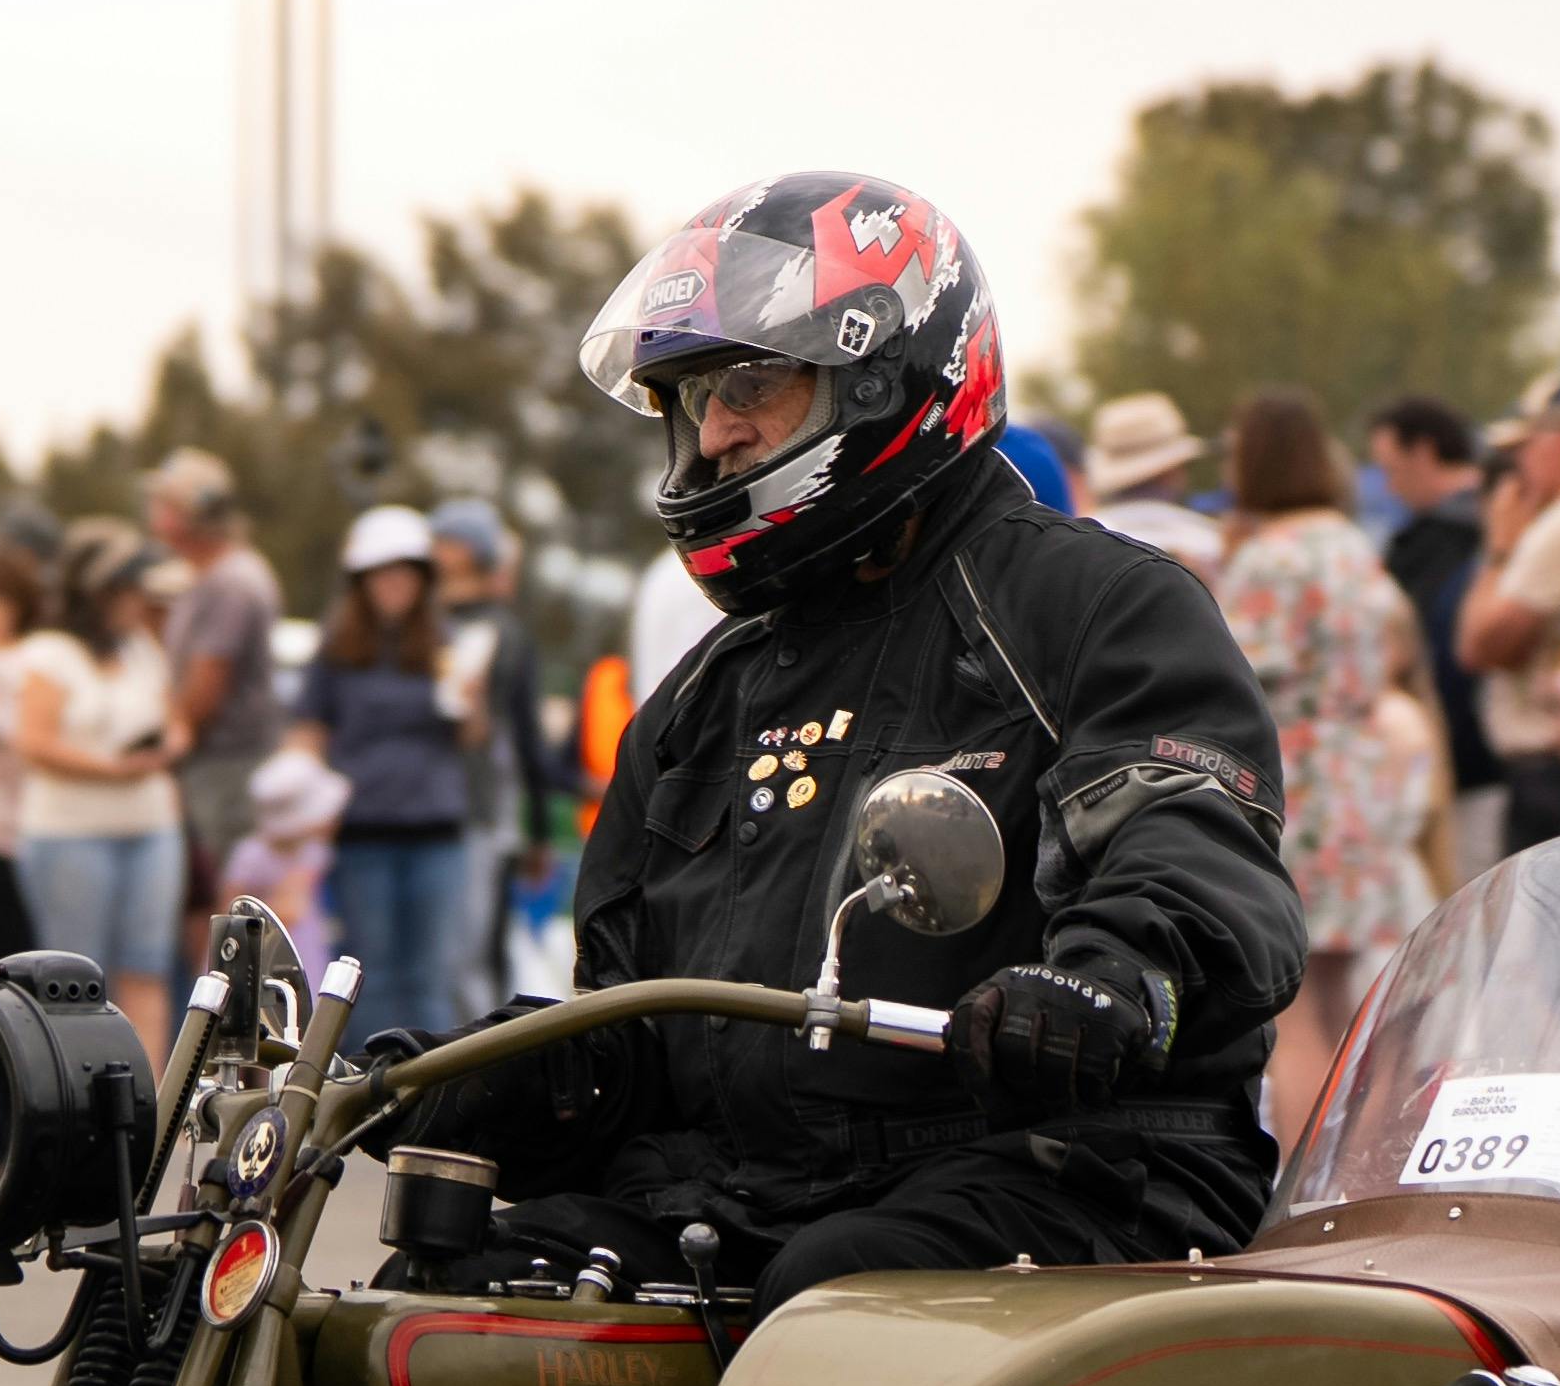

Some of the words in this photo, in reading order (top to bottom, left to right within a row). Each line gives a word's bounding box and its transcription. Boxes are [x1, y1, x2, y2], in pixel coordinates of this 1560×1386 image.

[644, 275, 696, 312] SHOEI
[922, 405, 944, 432] SHOEI
[1009, 966, 1093, 999] phoenix
[1418, 1134, 1529, 1175] 0389
